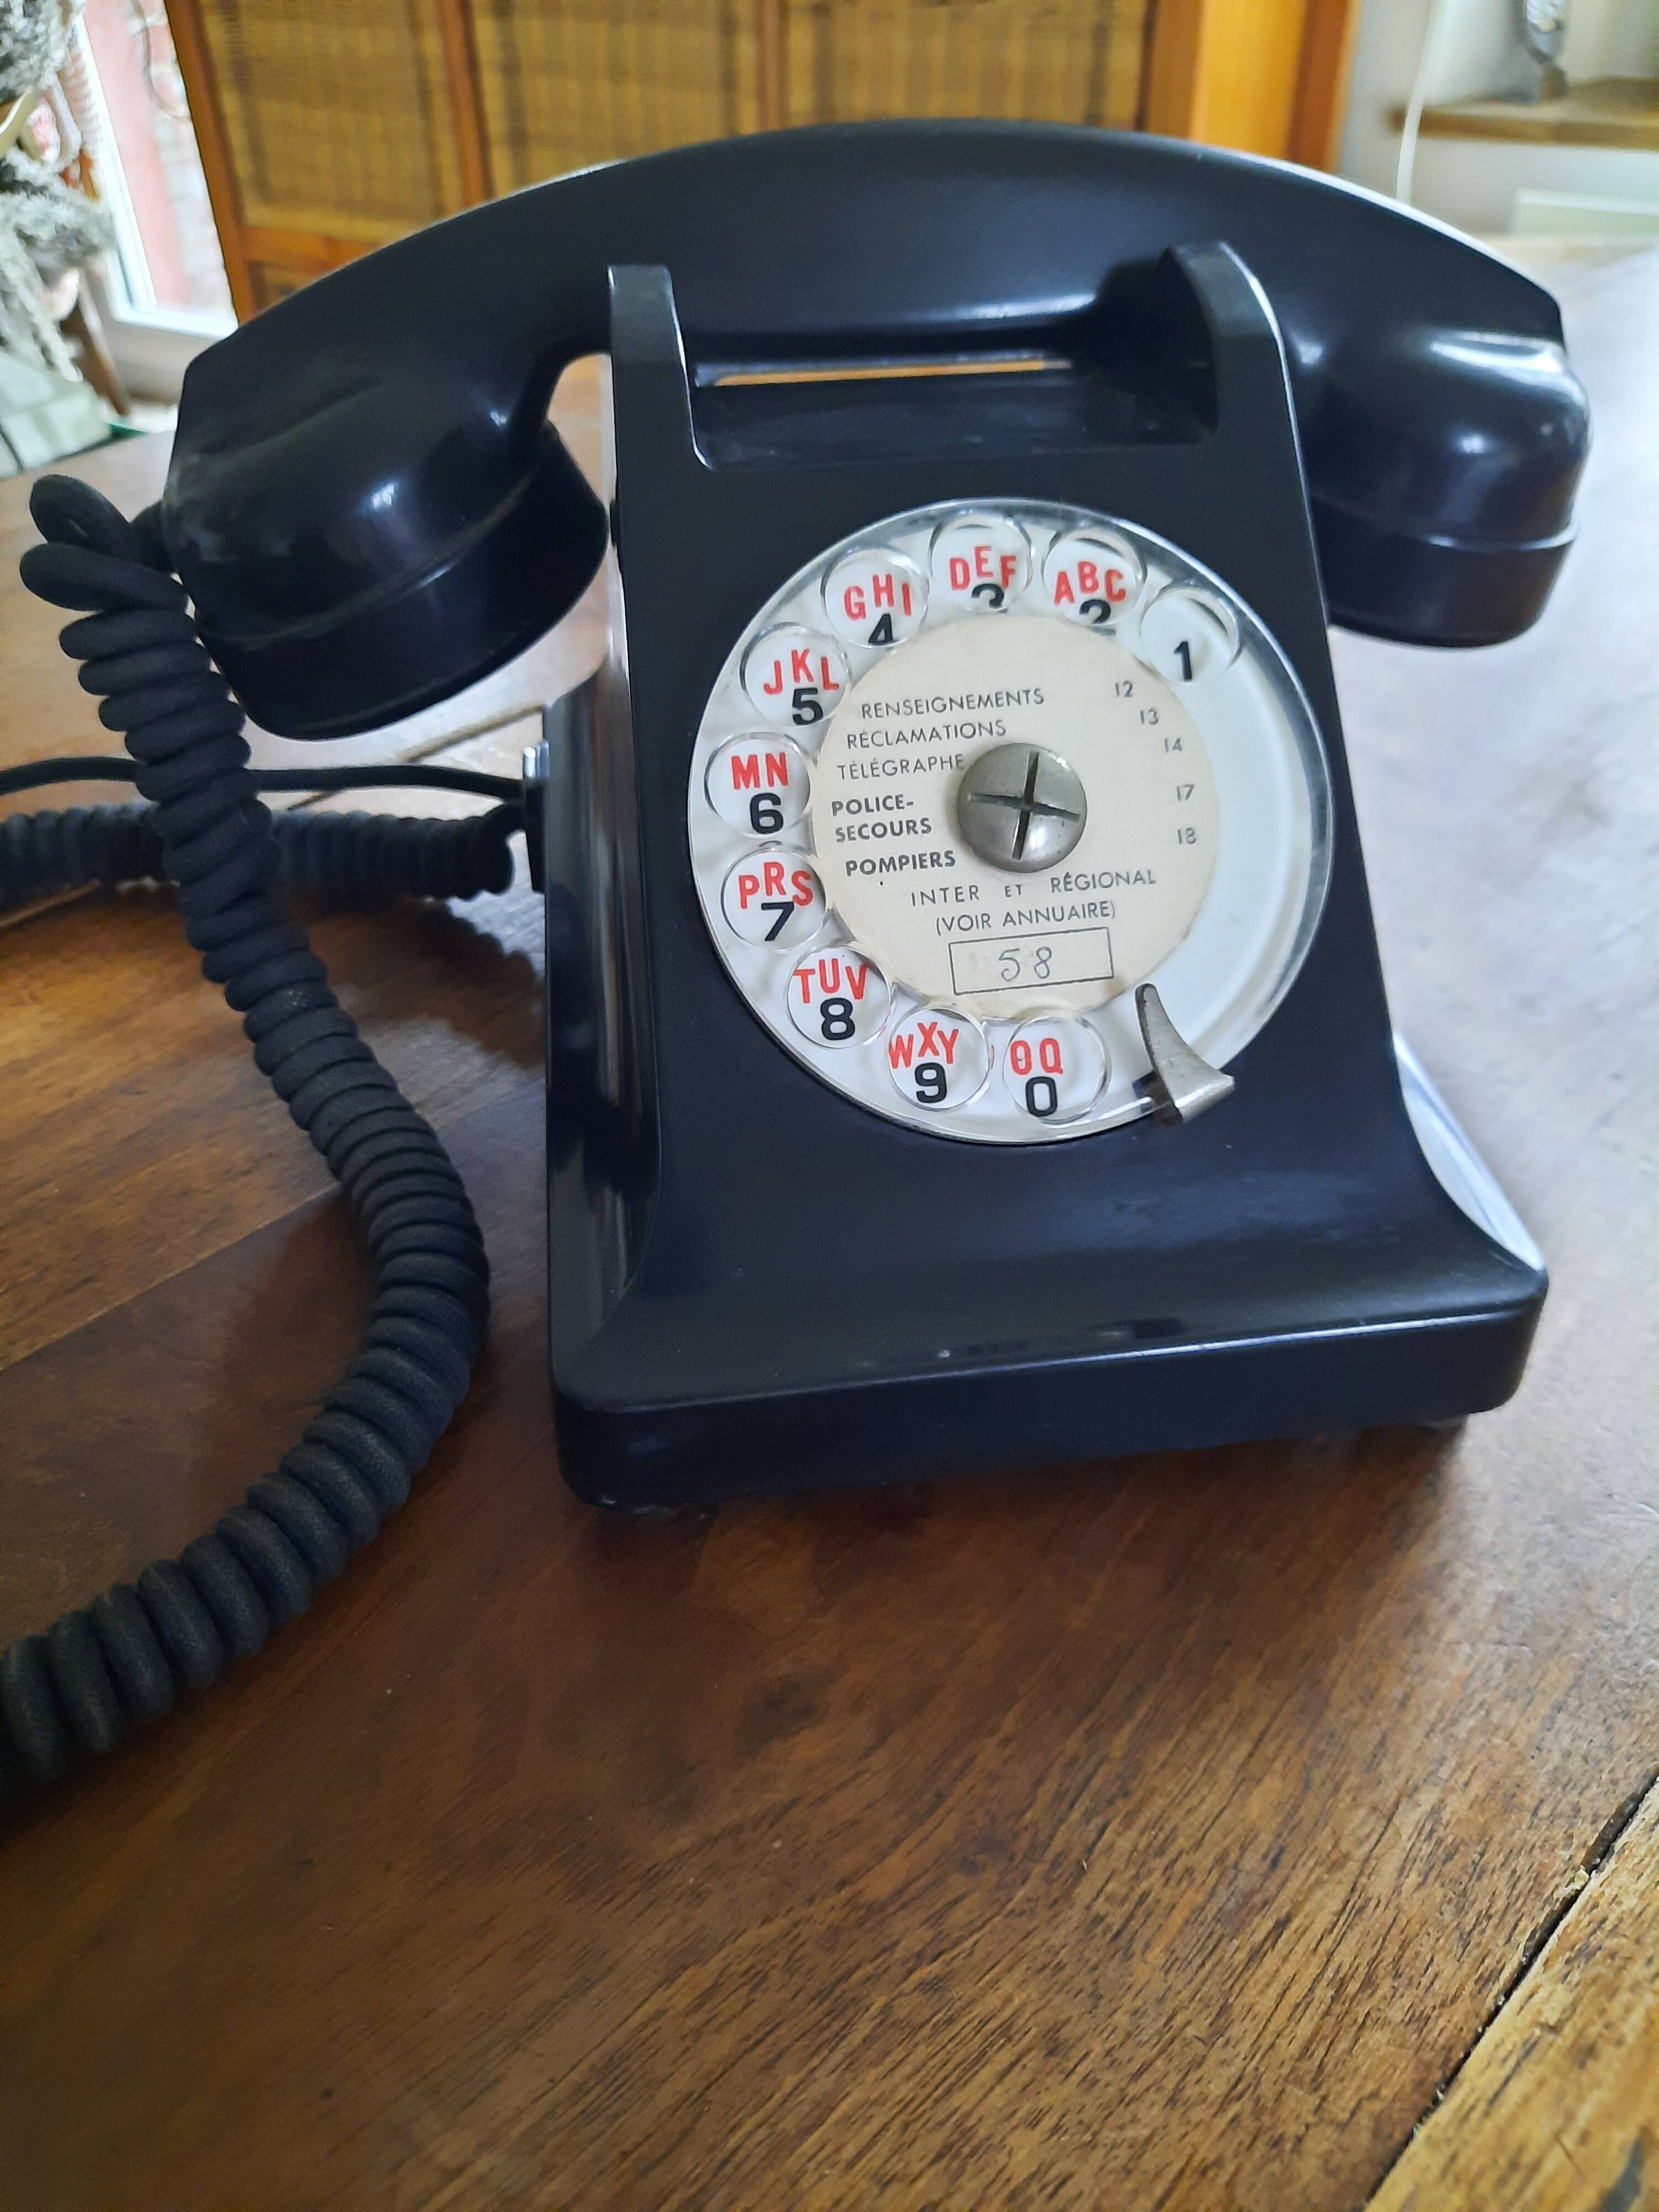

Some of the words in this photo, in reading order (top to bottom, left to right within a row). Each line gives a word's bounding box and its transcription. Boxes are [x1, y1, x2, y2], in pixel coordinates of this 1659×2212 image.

[950, 546, 1016, 591] DEF
[1054, 561, 1126, 605] ABC
[844, 574, 911, 621] GHI
[869, 614, 893, 645] 4
[763, 649, 839, 695] JKL
[1174, 641, 1192, 682] 1
[791, 687, 823, 726] 5
[862, 688, 1045, 719] RENSEIGNEMENTS
[1114, 681, 1133, 697] 12
[847, 719, 1006, 749] RÉCLAMATIONS
[1140, 708, 1159, 725] 13
[732, 752, 789, 790] MN
[837, 754, 965, 780] TÉLÉGRAPHE
[1164, 738, 1183, 753] 14
[832, 794, 914, 817] POLICE-
[1176, 784, 1194, 801] 17
[750, 793, 784, 834] 6
[834, 817, 932, 843] SECOURS
[846, 850, 956, 877] POMPIERS
[1177, 828, 1196, 844] 18
[738, 862, 813, 909] PRS
[911, 885, 979, 906] INTER
[1004, 884, 1023, 898] ET
[1051, 869, 1157, 894] RÉGIONAL
[761, 901, 795, 941] 7
[936, 912, 992, 936] (VOIR
[1002, 900, 1115, 928] ANNUAIRE)
[794, 958, 868, 1004] TUV
[998, 946, 1052, 982] 58
[820, 998, 854, 1040] 8
[889, 1021, 958, 1069] WXY
[1010, 1038, 1063, 1075] OQ
[915, 1063, 947, 1103] 9
[1025, 1076, 1058, 1117] 0
